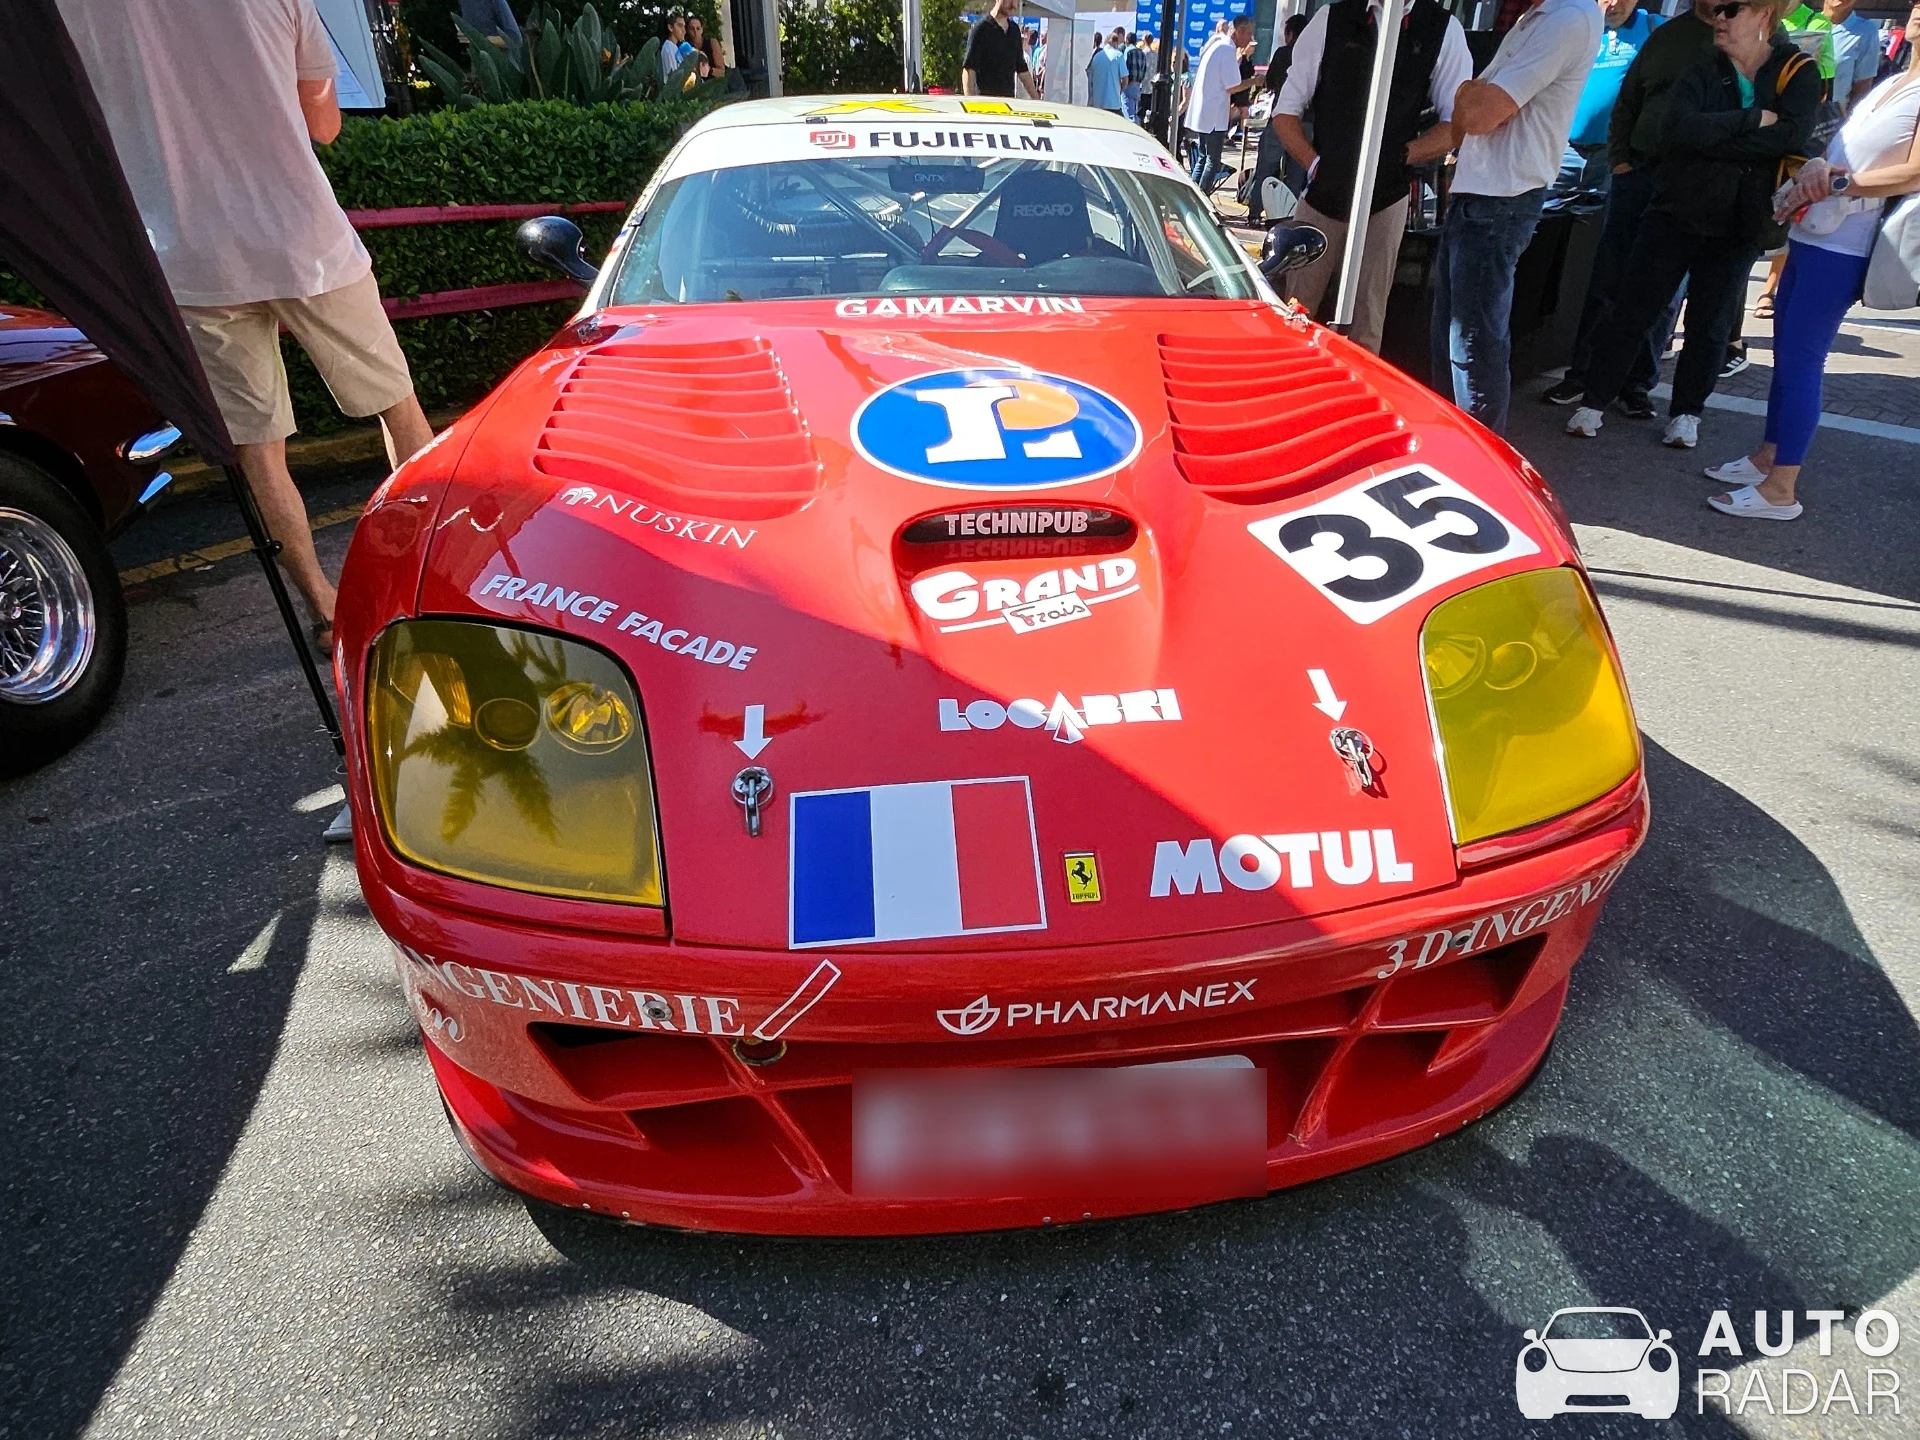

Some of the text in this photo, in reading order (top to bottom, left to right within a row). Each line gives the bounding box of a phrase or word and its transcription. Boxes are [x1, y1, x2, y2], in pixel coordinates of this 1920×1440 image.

[869, 131, 1054, 152] FUJIFILM
[914, 173, 946, 183] GNTX
[1013, 203, 1074, 217] RECARO
[835, 297, 1086, 318] GAMARVIN
[592, 494, 758, 549] NUSKIN
[944, 511, 1088, 536] TECHNIPUB
[1278, 470, 1510, 603] 35
[480, 574, 758, 671] FRANCE FACADE
[938, 688, 1182, 744] LOCABRI
[1150, 828, 1413, 898] MOTUL
[1007, 978, 1258, 1027] PHARMANEX
